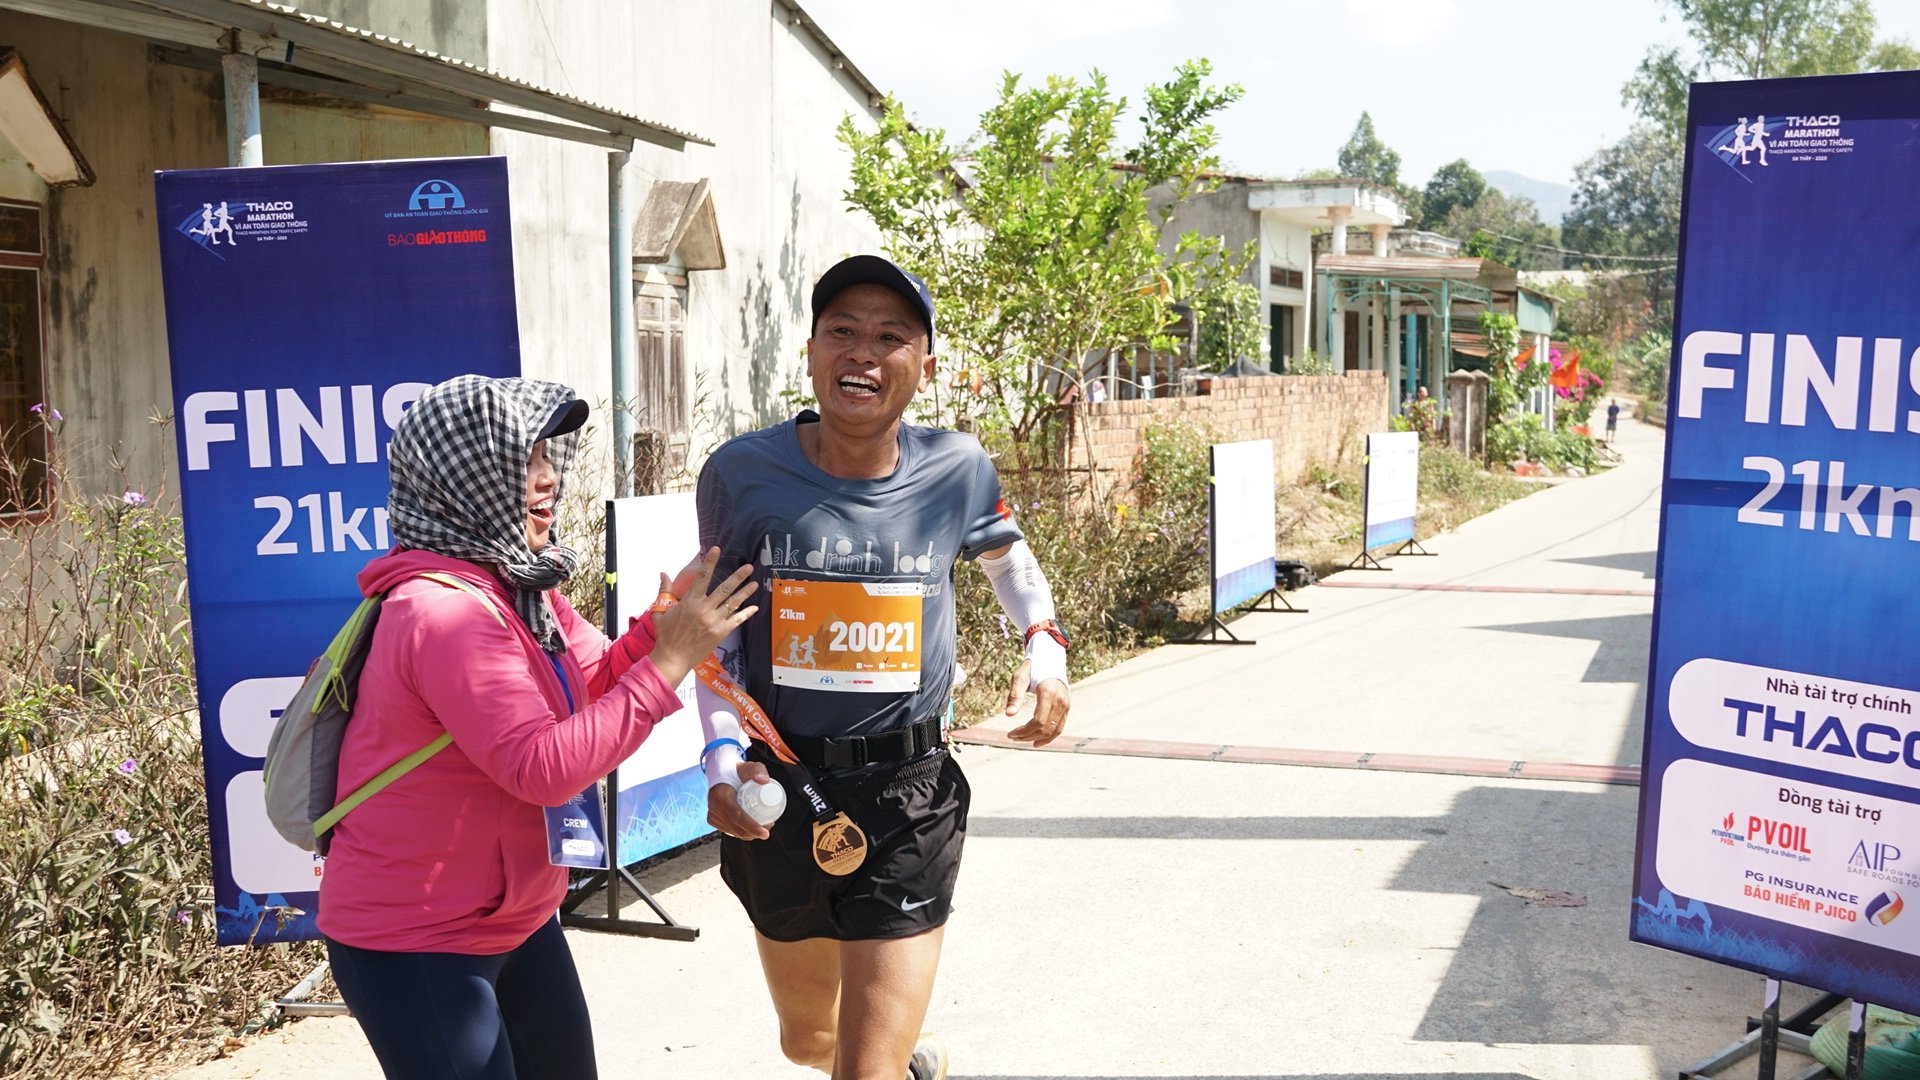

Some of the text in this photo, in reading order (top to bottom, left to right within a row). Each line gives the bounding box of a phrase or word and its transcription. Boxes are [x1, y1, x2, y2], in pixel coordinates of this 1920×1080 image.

[1785, 115, 1841, 127] THACO
[1777, 140, 1788, 148] AN
[1789, 139, 1809, 147] TOÀN
[1829, 138, 1854, 146] THÔNG
[1784, 128, 1840, 138] MARATHON
[245, 201, 294, 212] THACO
[247, 212, 295, 222] MARATHON
[286, 220, 308, 228] THÔNG
[1678, 330, 1920, 434] FINI
[760, 534, 800, 567] dak
[805, 536, 882, 573] drinh
[779, 608, 806, 621] 21km
[829, 621, 915, 653] 20021
[1766, 677, 1912, 715] Nhà tài trợ chính
[752, 711, 781, 749] THACO
[803, 783, 827, 813] 21km
[1778, 787, 1882, 826] Đồng tài trợ
[563, 817, 588, 829] CREW
[1720, 837, 1736, 847] PVOIL
[1747, 815, 1811, 854] PVOIL
[1771, 848, 1780, 856] xa
[1848, 839, 1901, 872] AIP
[1846, 865, 1869, 877] SAFE
[1871, 871, 1904, 885] ROADS
[1885, 868, 1920, 881] FOUND
[1744, 870, 1860, 905] PG INSURANCE
[1743, 883, 1858, 924] BẢO HIỂM PJICO
